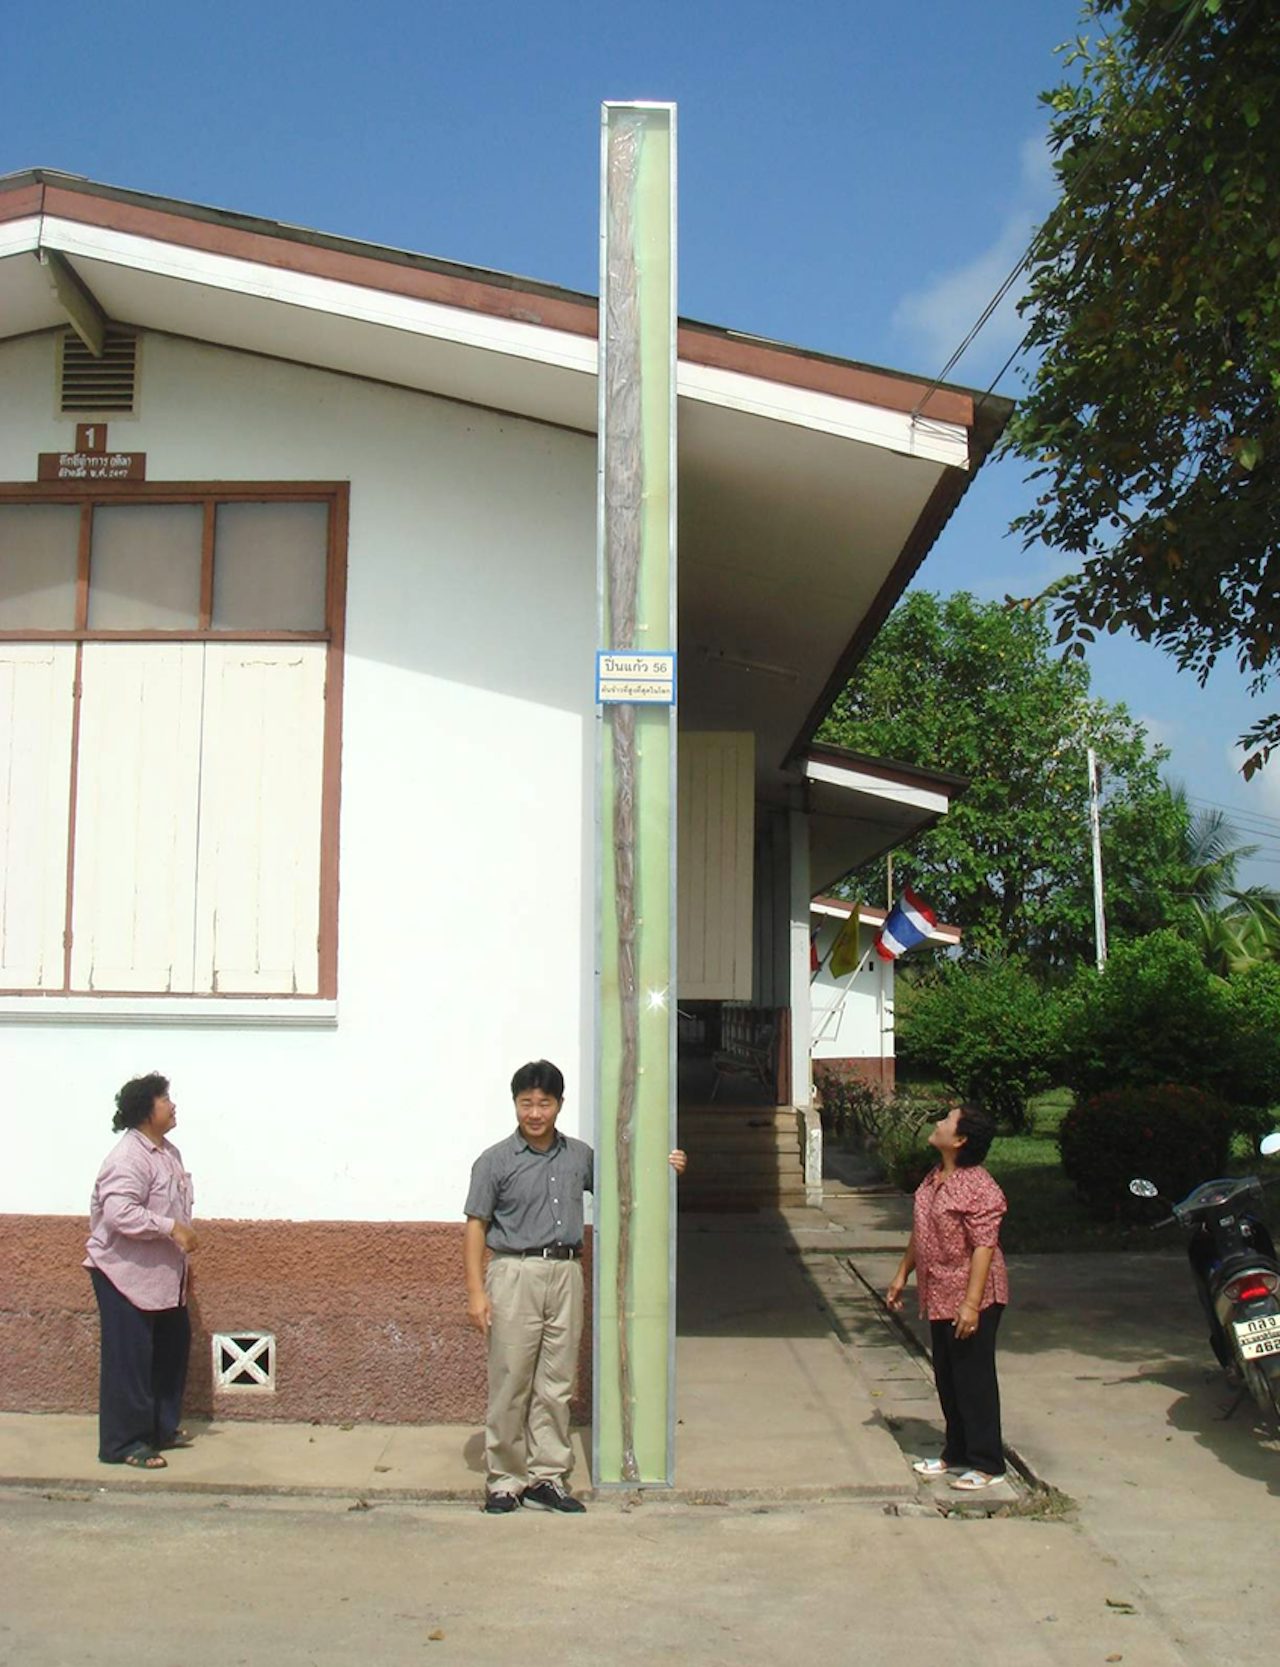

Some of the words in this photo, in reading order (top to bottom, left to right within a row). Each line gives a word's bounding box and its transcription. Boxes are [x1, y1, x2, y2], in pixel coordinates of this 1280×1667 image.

[85, 427, 95, 449] 1
[604, 656, 649, 672] ปิ่นแก้ว
[652, 662, 668, 673] 56
